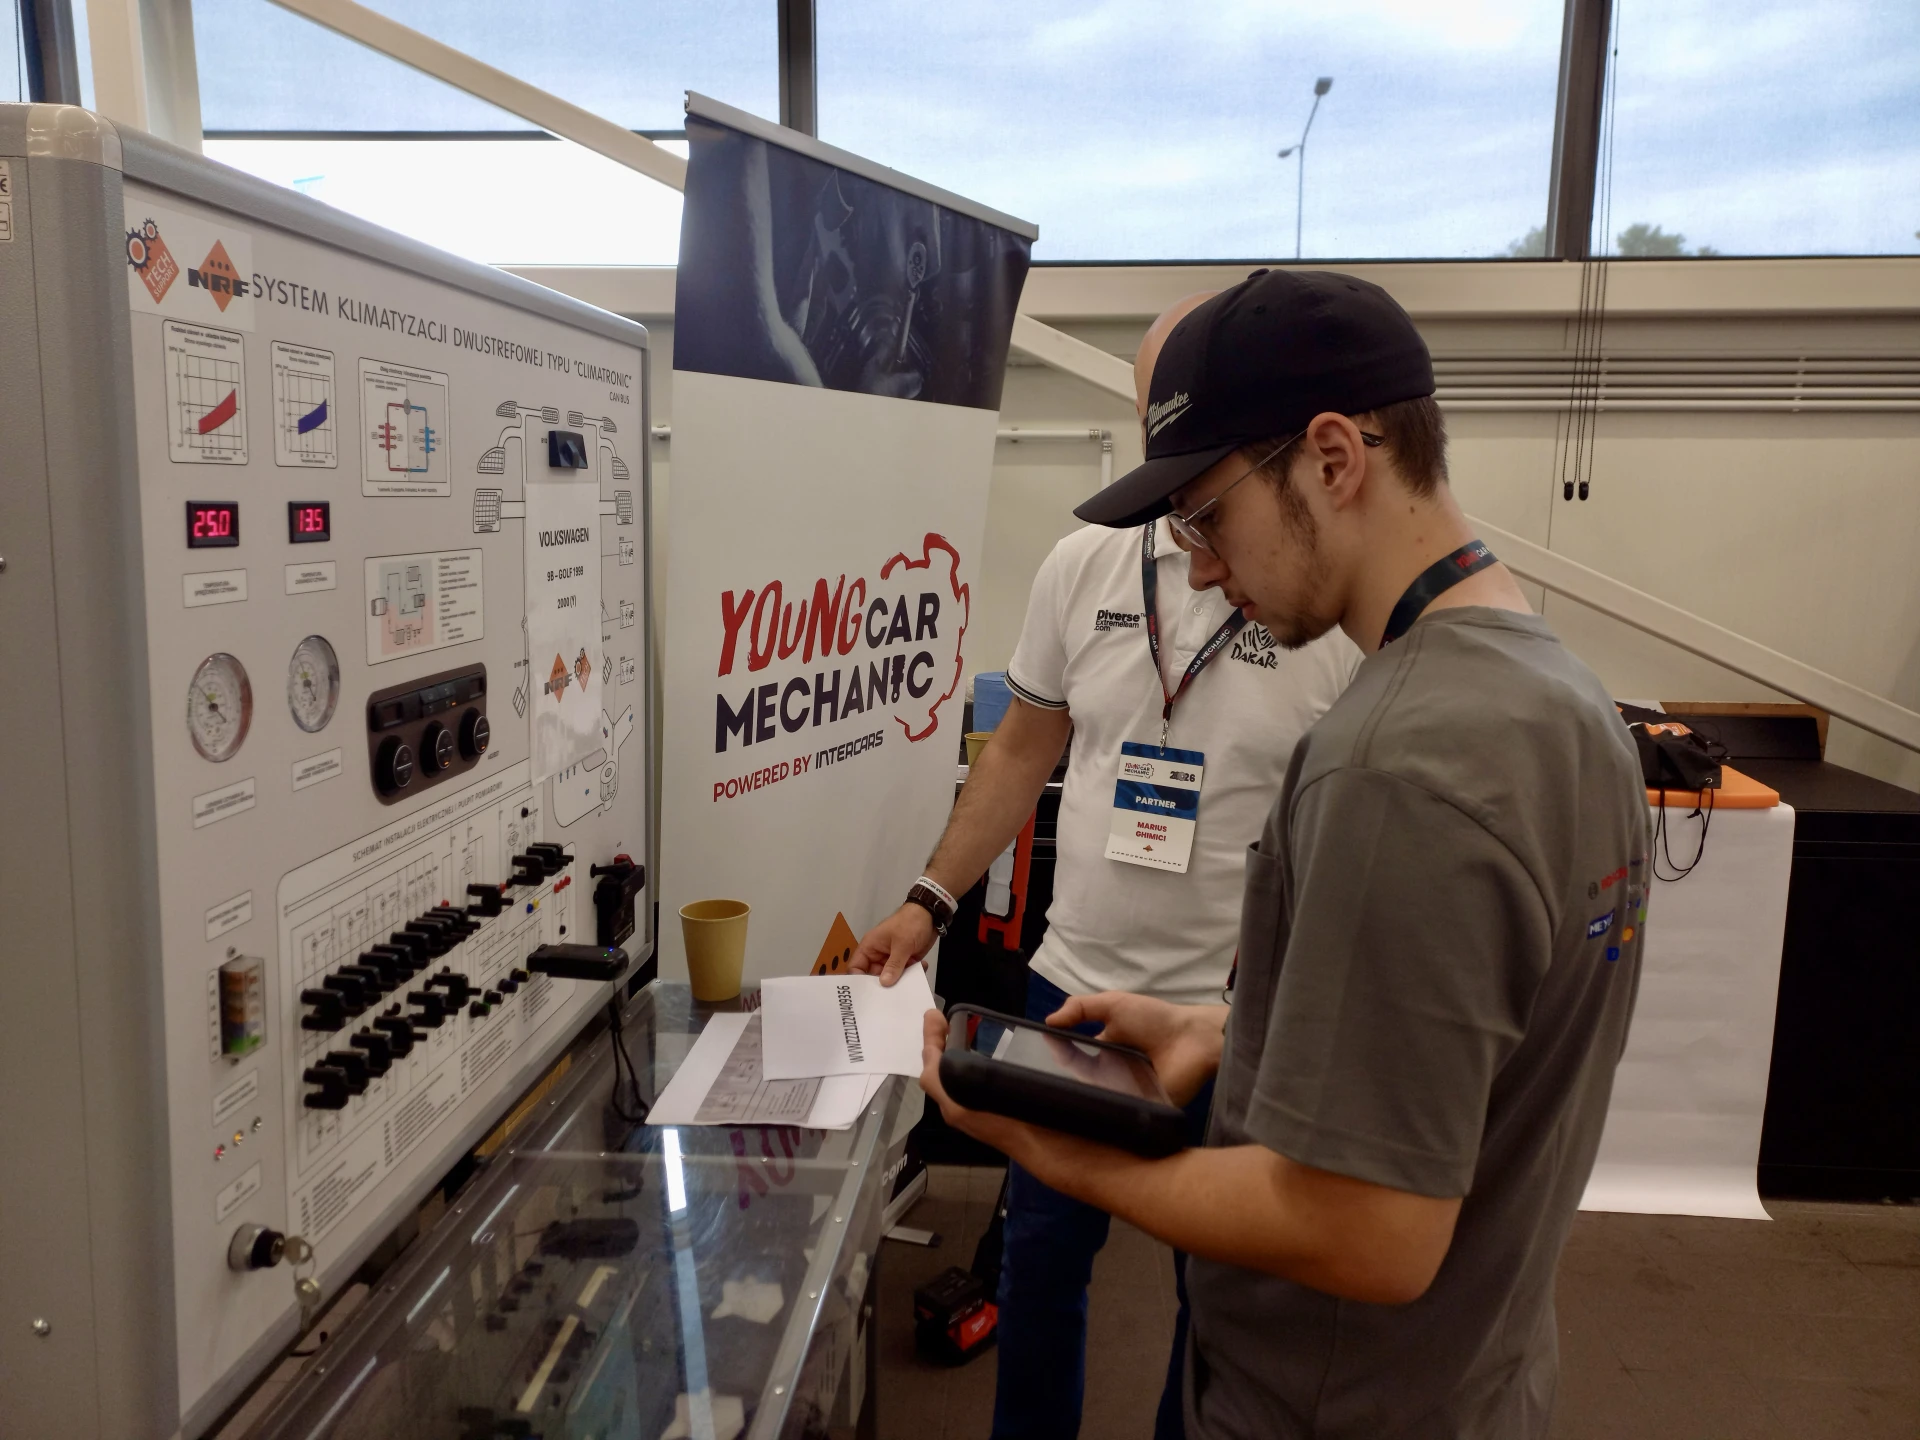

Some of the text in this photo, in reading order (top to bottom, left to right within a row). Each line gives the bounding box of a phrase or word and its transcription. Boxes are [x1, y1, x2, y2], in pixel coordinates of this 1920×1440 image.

[146, 251, 171, 287] TECH
[153, 264, 175, 297] SUPPORT
[187, 268, 249, 297] NRF
[252, 273, 329, 315] SYSTEM
[338, 295, 447, 344] KLIMATYZACJI
[453, 327, 543, 367] DWUSTREFOWEJ
[547, 352, 570, 374] TYPU
[610, 391, 620, 402] CAN
[1148, 390, 1190, 433] Milwaukee
[538, 527, 589, 548] VOLKSWAGEN
[547, 570, 555, 582] 9B
[558, 567, 573, 580] GOLF
[557, 597, 570, 610] 2000
[1096, 609, 1141, 623] Diverse
[717, 573, 941, 678] YOUNG CAR
[1095, 619, 1140, 629] ExtremeTeam
[1190, 659, 1203, 673] CAR
[1200, 628, 1231, 661] MECHANIC
[1230, 642, 1277, 669] DAKAR
[543, 673, 573, 695] NRF
[715, 651, 935, 754] MECHANIC
[713, 730, 884, 802] POWERED BY INTERCARS
[1135, 795, 1177, 810] PARTNER
[352, 840, 383, 863] SCHEMAT
[383, 825, 416, 846] INSTALACJI
[416, 805, 454, 831] ELEKTRYCZNEJ
[458, 794, 475, 809] PULPIT
[475, 780, 504, 801] POMIAROWY
[1137, 821, 1168, 832] MARIUS
[1135, 830, 1167, 842] GHIMICI
[882, 1153, 908, 1187] com
